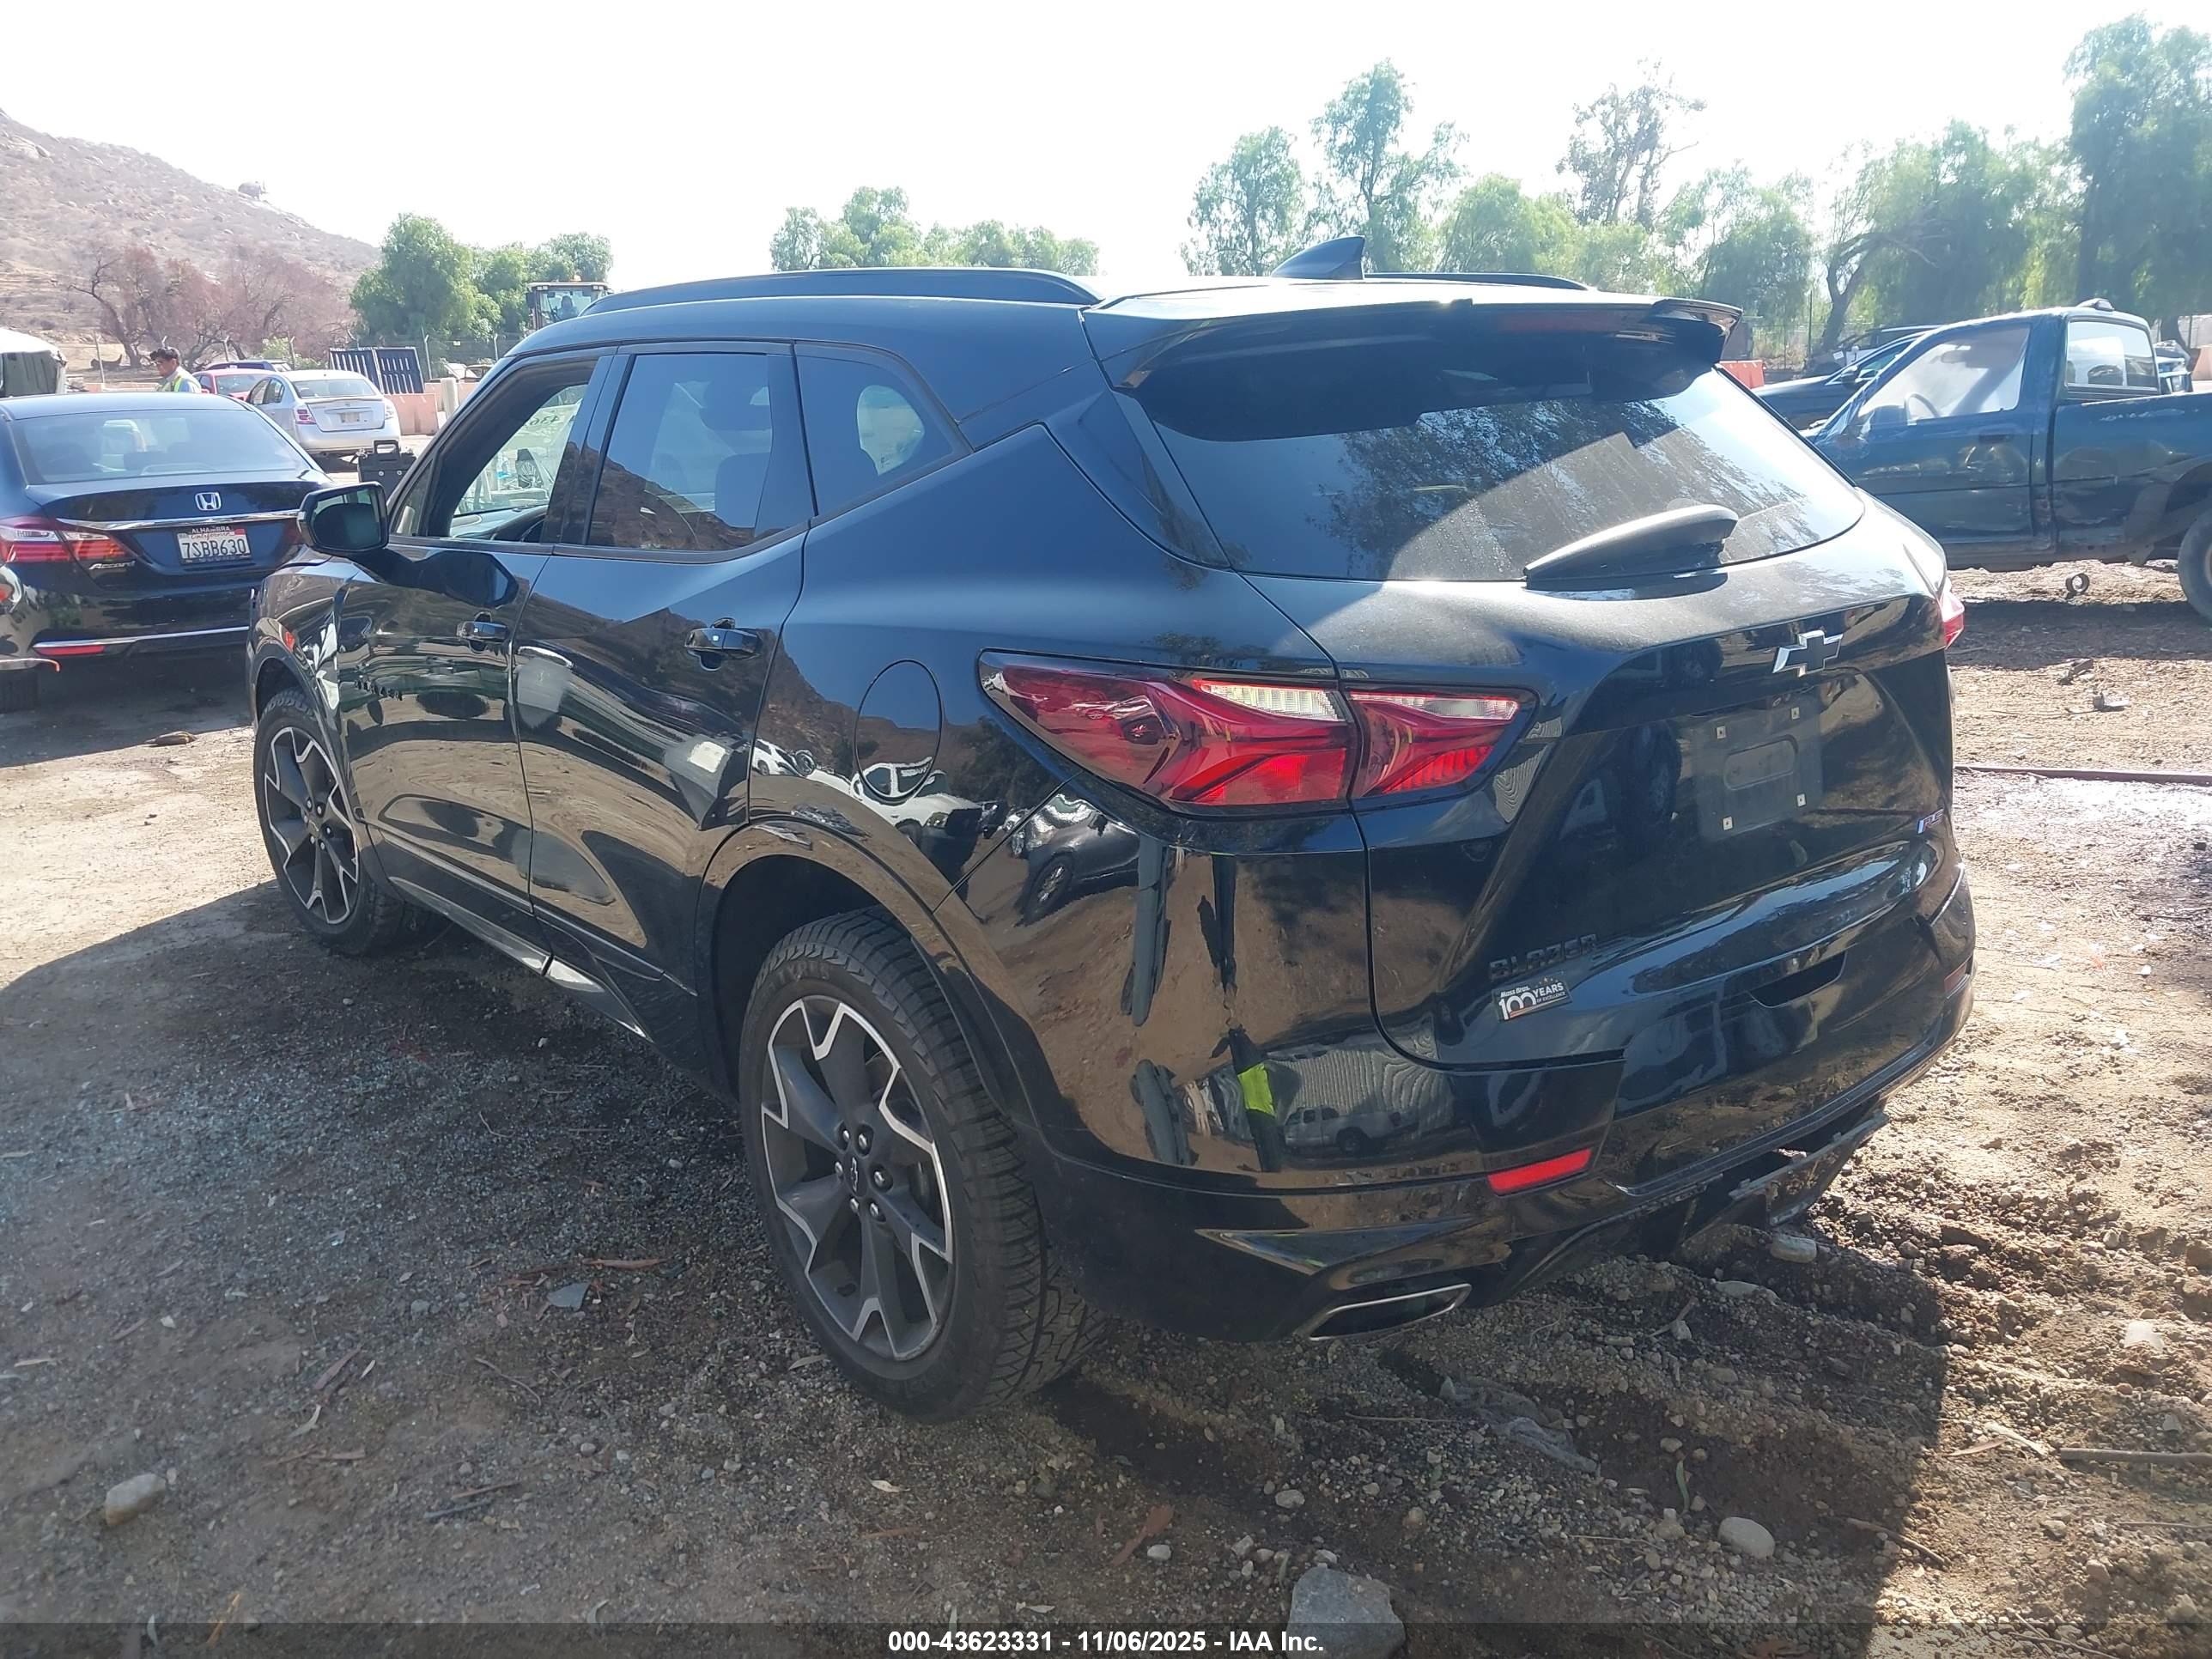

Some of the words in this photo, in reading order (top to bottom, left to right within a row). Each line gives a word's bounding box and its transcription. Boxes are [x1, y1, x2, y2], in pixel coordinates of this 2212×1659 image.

[181, 538, 247, 560] 7SBB630
[1490, 933, 1597, 982] BLAZER
[1498, 992, 1537, 1020] 100
[1532, 981, 1565, 998] YEARS
